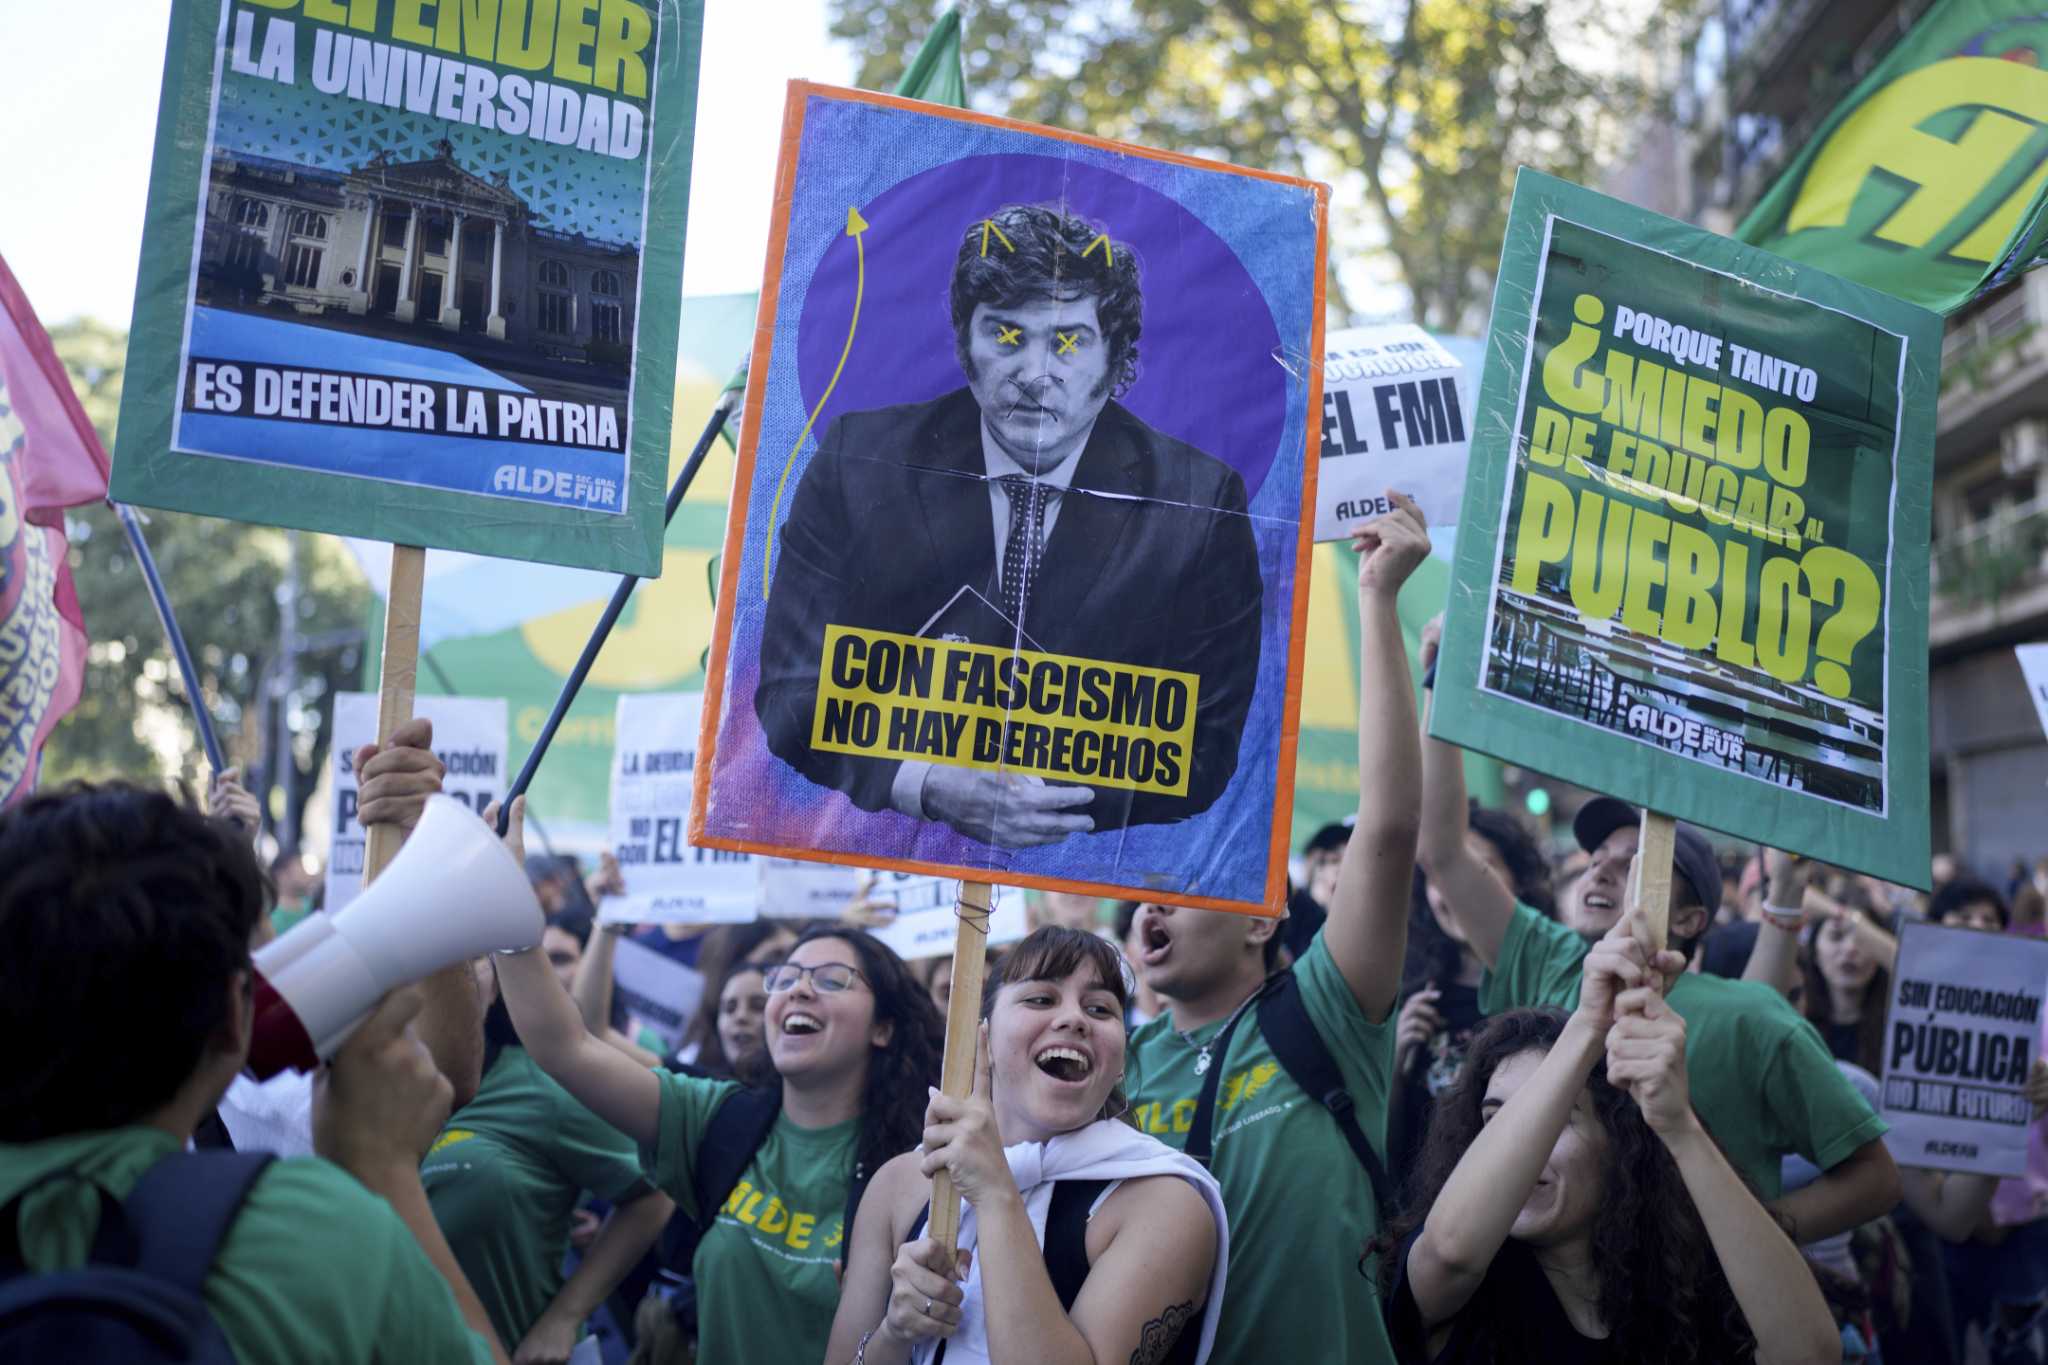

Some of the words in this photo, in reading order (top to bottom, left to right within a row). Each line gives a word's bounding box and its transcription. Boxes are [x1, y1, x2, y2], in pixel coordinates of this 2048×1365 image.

[231, 10, 295, 85] LA
[311, 28, 645, 160] UNIVERSIDAD
[1543, 294, 1811, 488] ¿MIEDO
[1613, 304, 1724, 368] PORQUE
[1728, 344, 1819, 402] TANTO
[195, 363, 242, 413] ES
[254, 368, 435, 430] DEFENDER
[446, 388, 488, 435] LA
[498, 394, 619, 449] PATRIA
[1320, 390, 1368, 458] EL
[1372, 377, 1466, 450] FMI
[494, 465, 575, 498] ALDE
[574, 484, 616, 505] FUR
[1529, 406, 1598, 480] DE
[1606, 431, 1806, 552] EDUCAR
[1511, 472, 1882, 698] PUEBLO?
[831, 634, 935, 699] CON
[942, 649, 1188, 732] FASCISMO
[822, 697, 881, 748] NO
[887, 706, 969, 758] HAY
[972, 716, 1183, 787] DERECHOS
[1628, 704, 1701, 748] ALDE
[1701, 736, 1743, 761] FUR
[654, 818, 683, 863] EL
[1899, 979, 1932, 1009] SIN
[1935, 985, 2039, 1023] EDUCACIÓN
[1891, 1014, 2030, 1084] PÚBLICA
